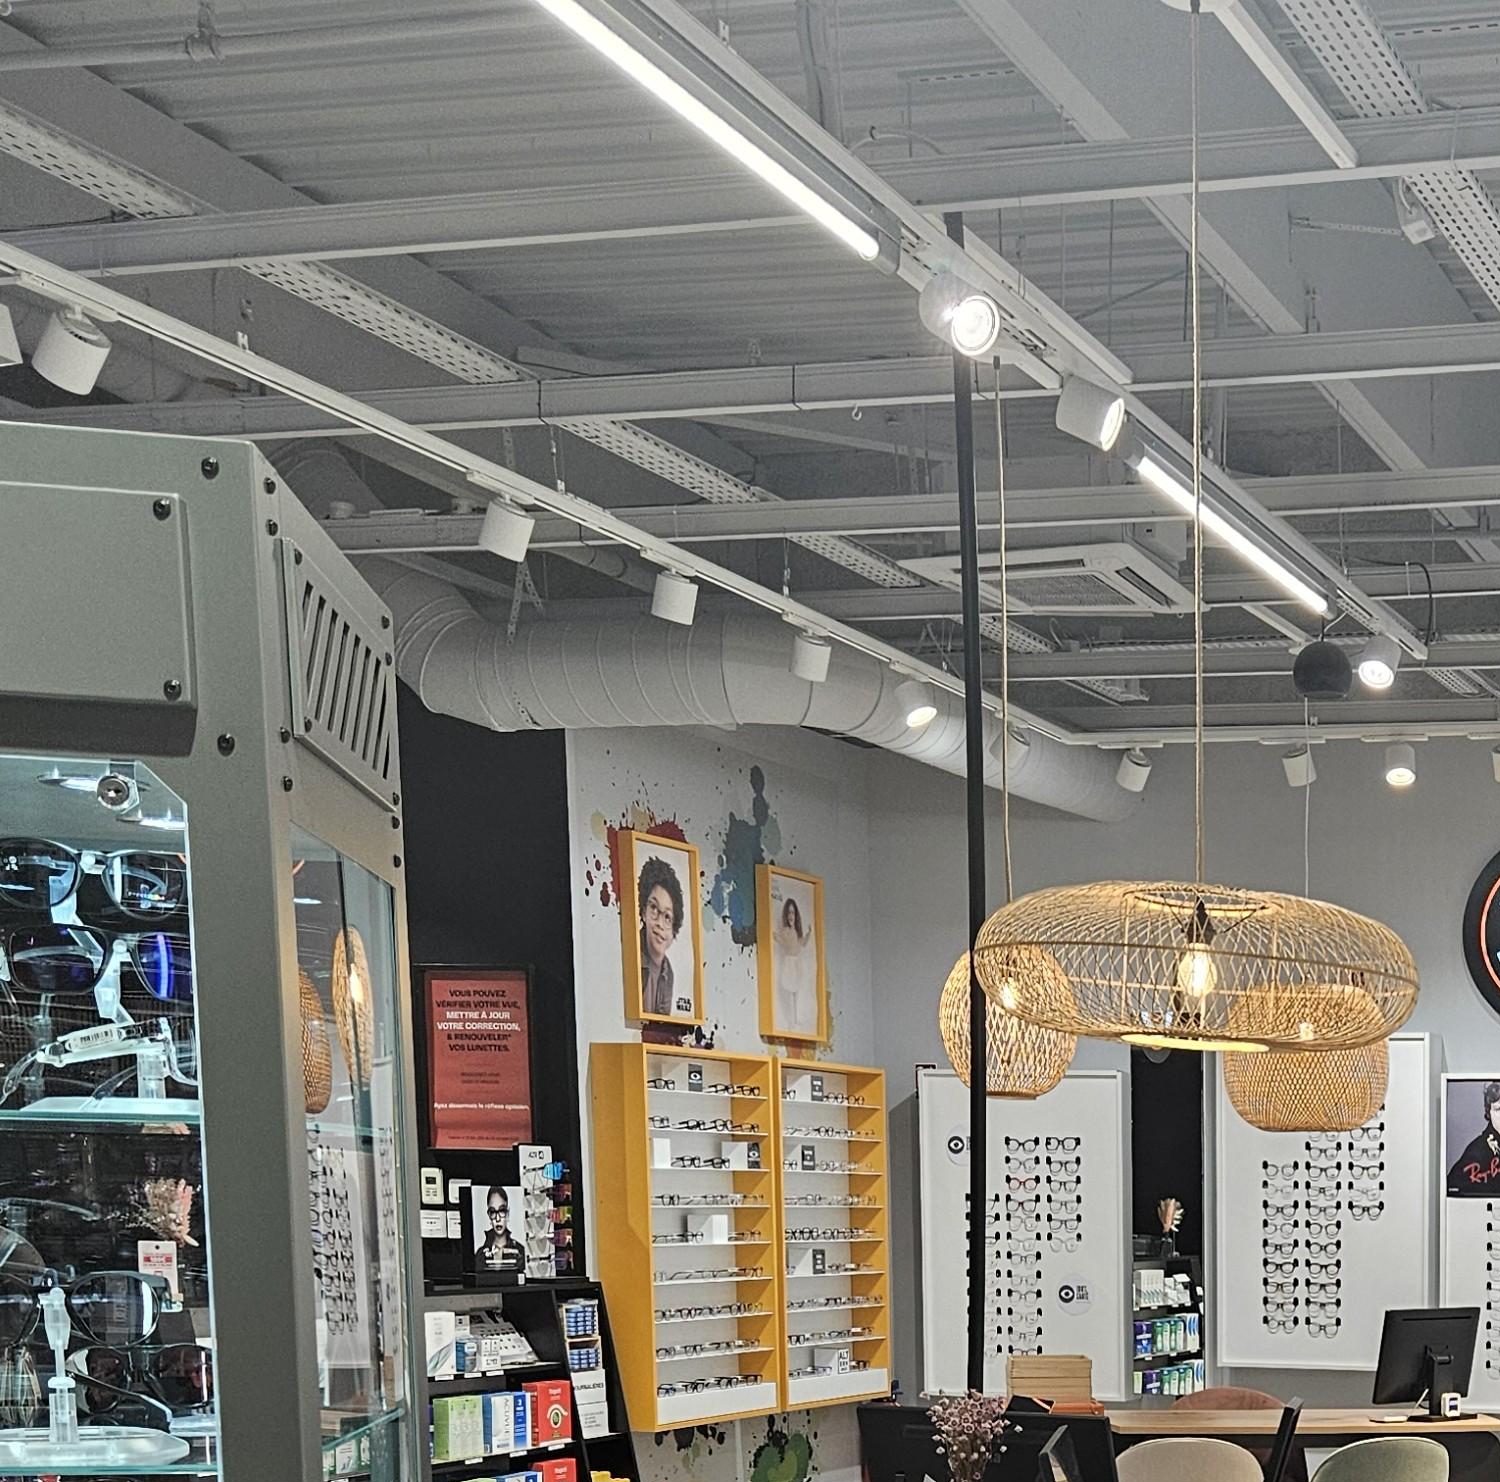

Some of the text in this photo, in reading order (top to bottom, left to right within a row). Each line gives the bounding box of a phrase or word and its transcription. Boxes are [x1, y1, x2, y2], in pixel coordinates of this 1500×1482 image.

[446, 1011, 479, 1019] METTRE
[488, 1011, 510, 1019] JOUR
[437, 1022, 521, 1031] VOTRE CORRECTION,
